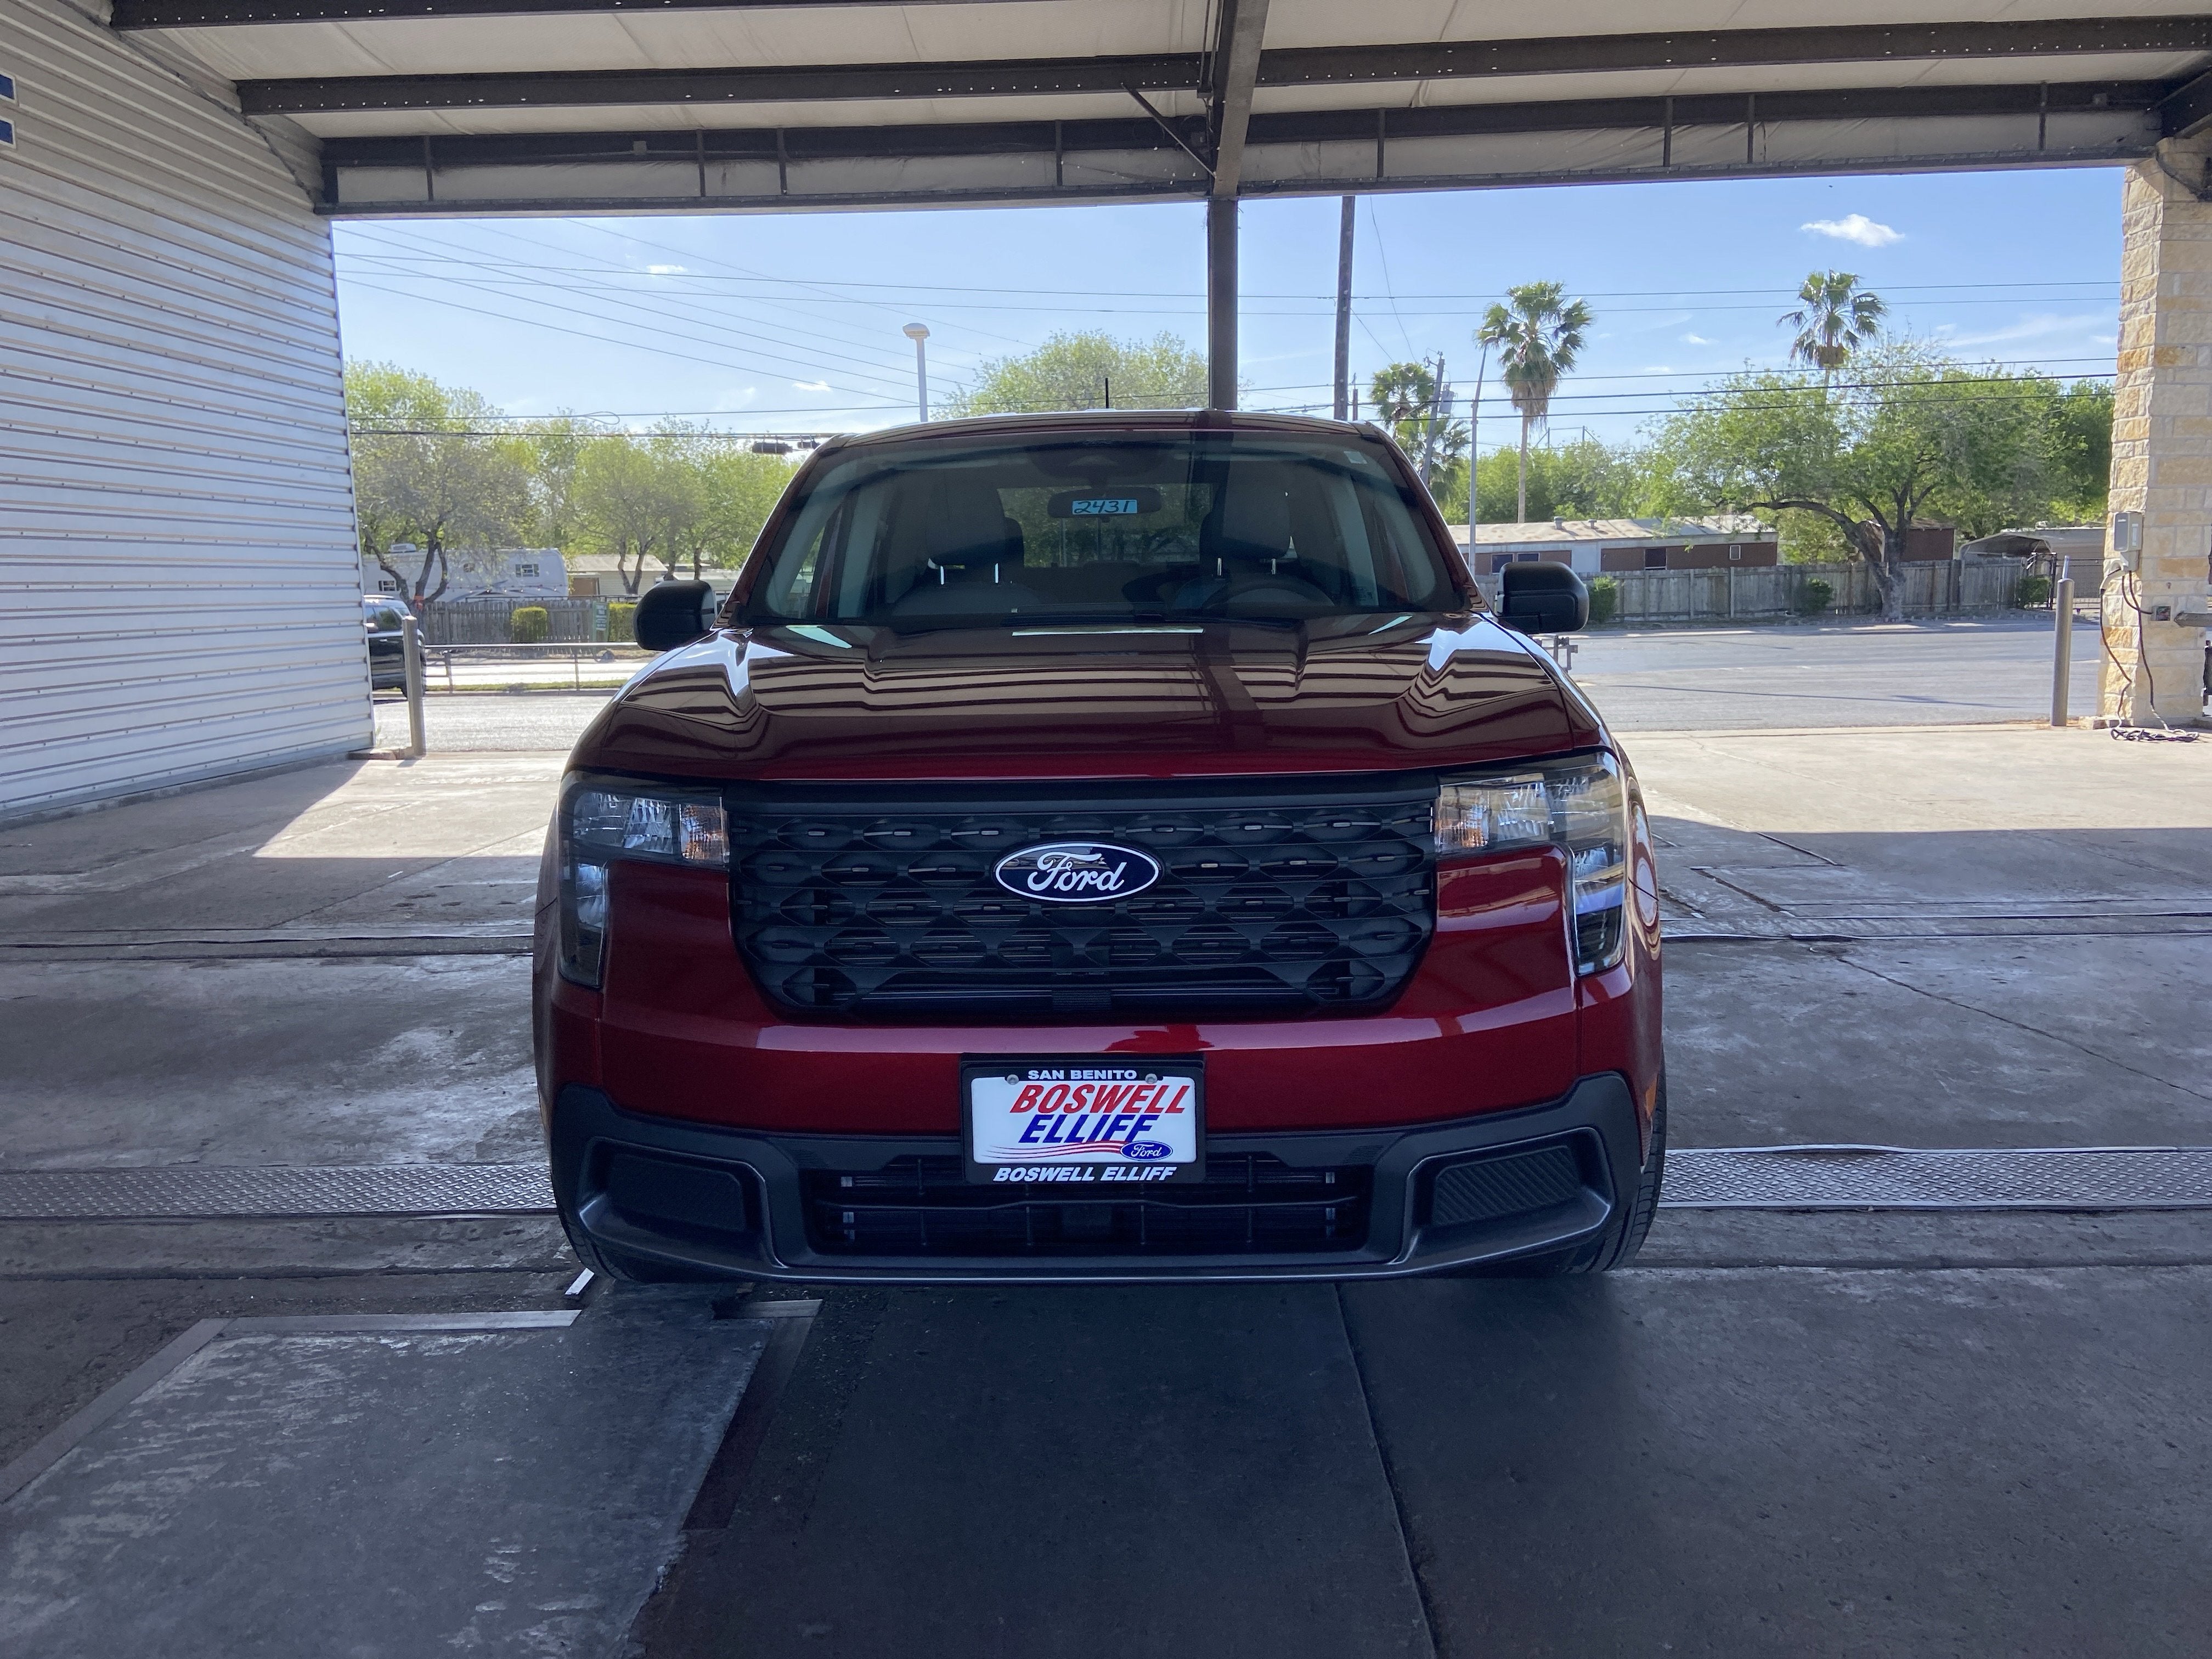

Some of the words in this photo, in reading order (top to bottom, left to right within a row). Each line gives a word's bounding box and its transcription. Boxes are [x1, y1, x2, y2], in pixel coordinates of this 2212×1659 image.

[1027, 851, 1127, 891] Ford
[1028, 1070, 1064, 1080] SAN
[1070, 1070, 1137, 1080] BENITO
[1009, 1084, 1190, 1114] BOSWELL
[1018, 1114, 1161, 1143] ELLIFF
[1130, 1144, 1162, 1158] Ford
[993, 1167, 1096, 1182] BOSWELL
[1100, 1166, 1177, 1182] ELLIFF
